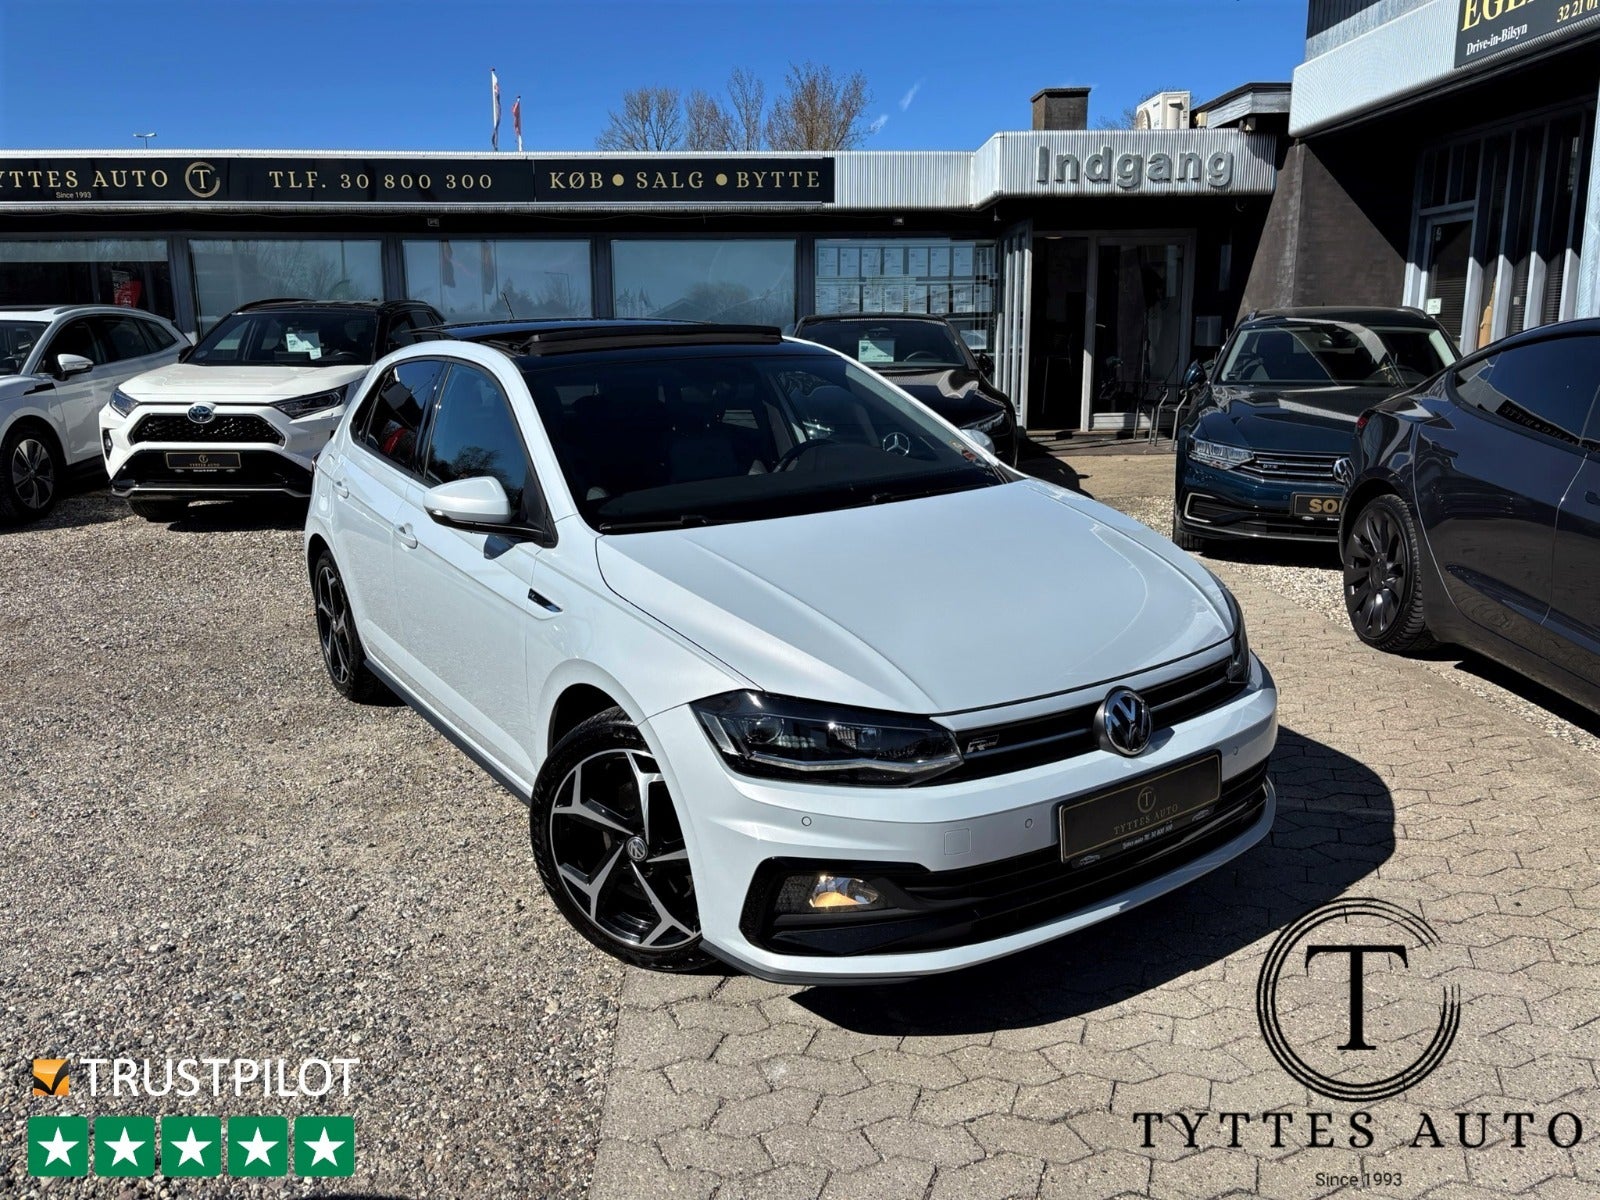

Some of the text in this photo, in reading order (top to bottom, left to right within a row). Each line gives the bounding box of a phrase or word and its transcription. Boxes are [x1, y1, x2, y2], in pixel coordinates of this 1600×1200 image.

[1557, 4, 1570, 22] 32
[1571, 0, 1583, 17] 21
[1466, 24, 1528, 56] Drive-in-Bilsyn
[1035, 145, 1234, 189] Indgang
[92, 170, 168, 188] AUTO
[269, 171, 492, 189] TLF. 30 800 300
[550, 170, 820, 189] KØB SALG BYTTE
[55, 191, 92, 199] Since 1993
[1113, 803, 1178, 835] TYTTES AUTO
